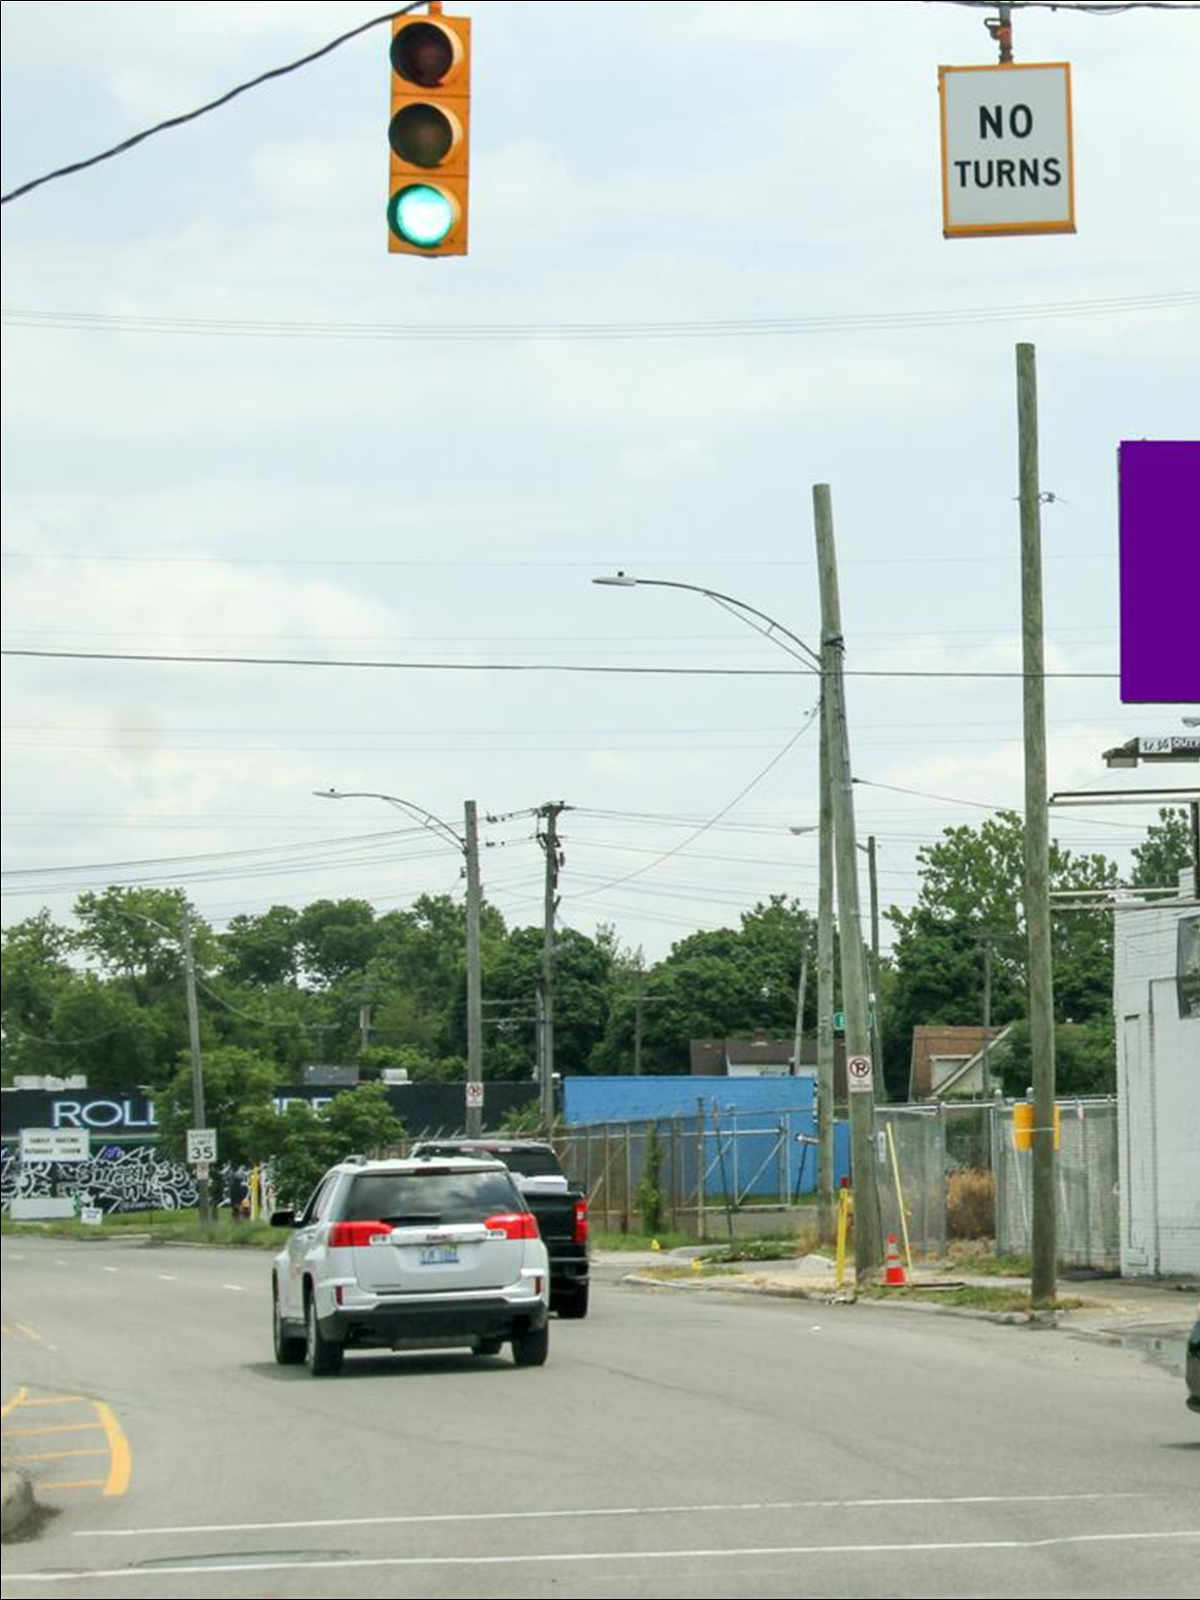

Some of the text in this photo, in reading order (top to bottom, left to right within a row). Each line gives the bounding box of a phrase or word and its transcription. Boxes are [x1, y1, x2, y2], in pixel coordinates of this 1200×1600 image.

[979, 104, 1033, 139] NO
[954, 157, 1062, 188] TURNS
[192, 1146, 213, 1159] 35
